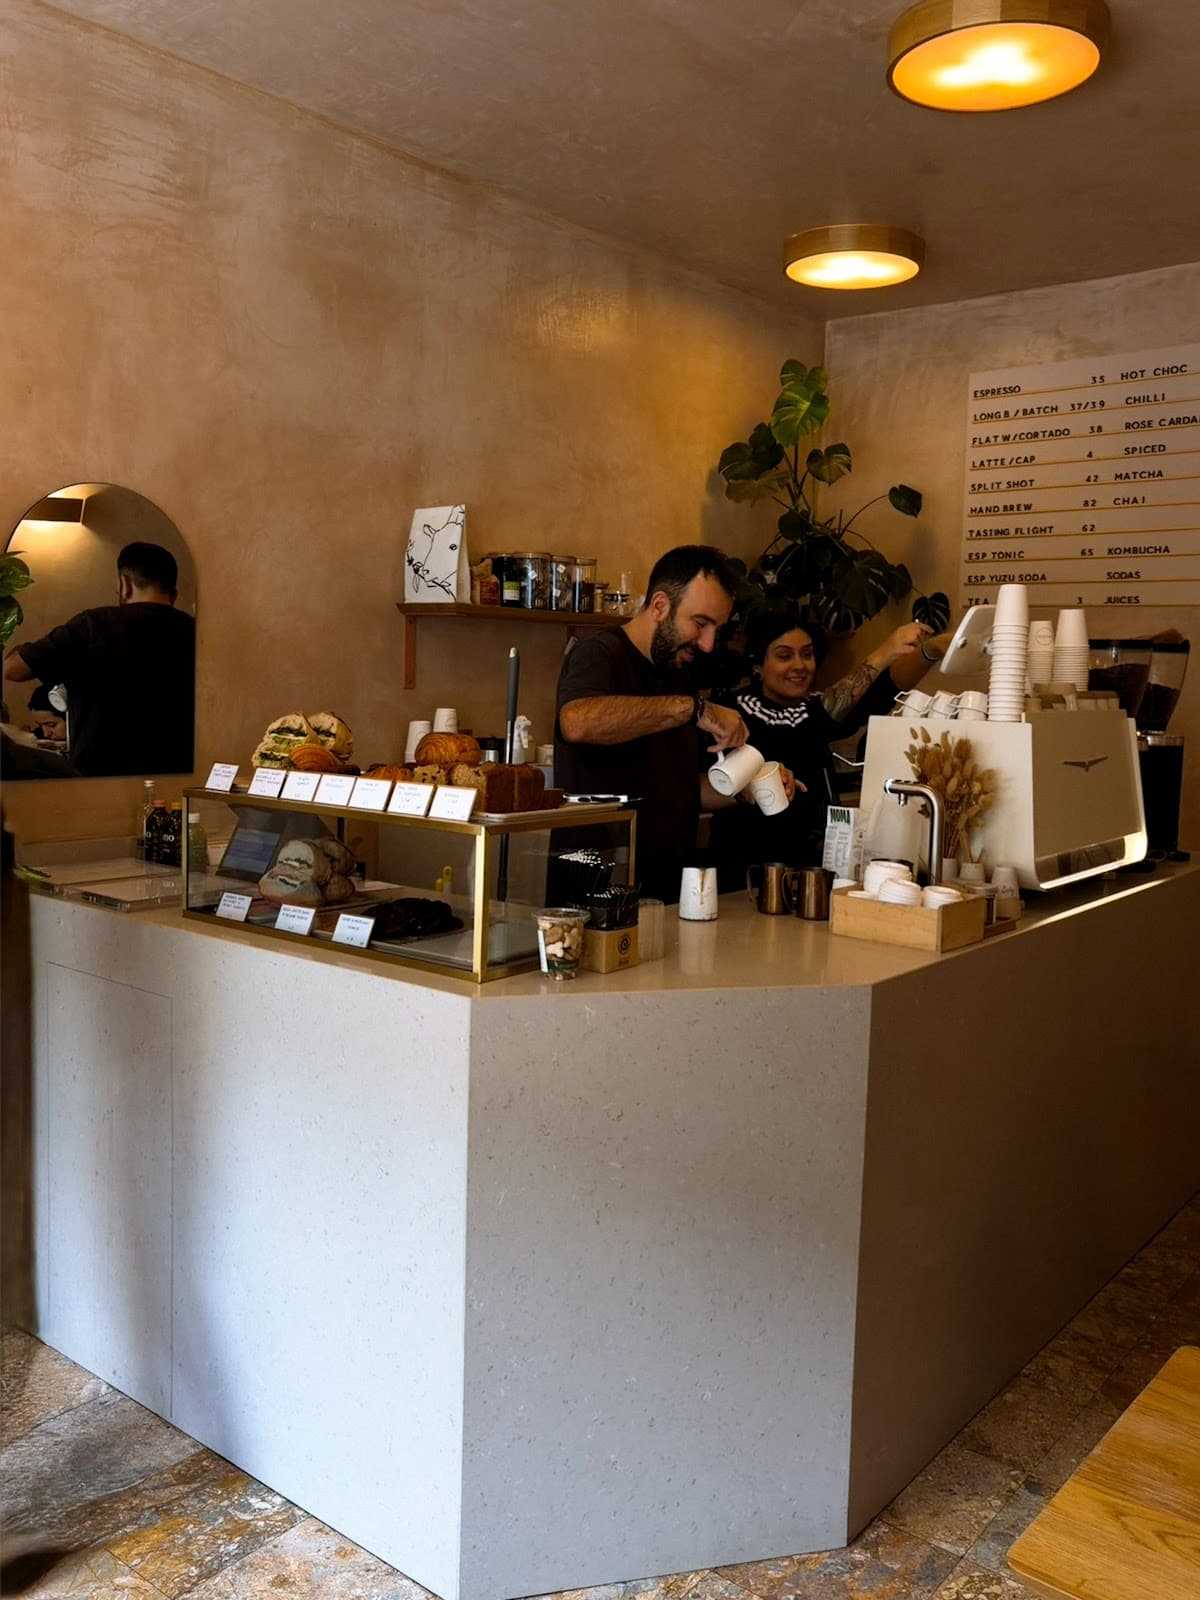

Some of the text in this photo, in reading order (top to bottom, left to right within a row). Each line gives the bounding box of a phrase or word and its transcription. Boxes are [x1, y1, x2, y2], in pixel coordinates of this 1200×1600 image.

[1120, 364, 1188, 381] HOT CHOC
[973, 385, 1021, 399] ESPRESSO
[1125, 393, 1166, 406] CHILLI
[1125, 414, 1200, 431] ROSE CARDA
[972, 434, 999, 446] FLAT
[1086, 451, 1093, 459] 4
[1124, 443, 1167, 456] SPICED
[1114, 469, 1164, 482] MATCHA
[970, 479, 1035, 492] SPLIT SHOT
[1083, 499, 1097, 508] 82
[1113, 496, 1146, 507] CHAI
[1014, 525, 1054, 536] FLIGHT
[1081, 524, 1096, 533] 62
[968, 550, 1025, 561] ESP TONIC
[1080, 548, 1094, 557] 65
[1107, 545, 1171, 556] KOMBUCHA
[967, 573, 1047, 584] ESP YUZU SODA
[1106, 570, 1141, 580] SODAS
[968, 597, 989, 605] TEA
[1076, 596, 1083, 605] 3
[1104, 595, 1141, 605] JUICES
